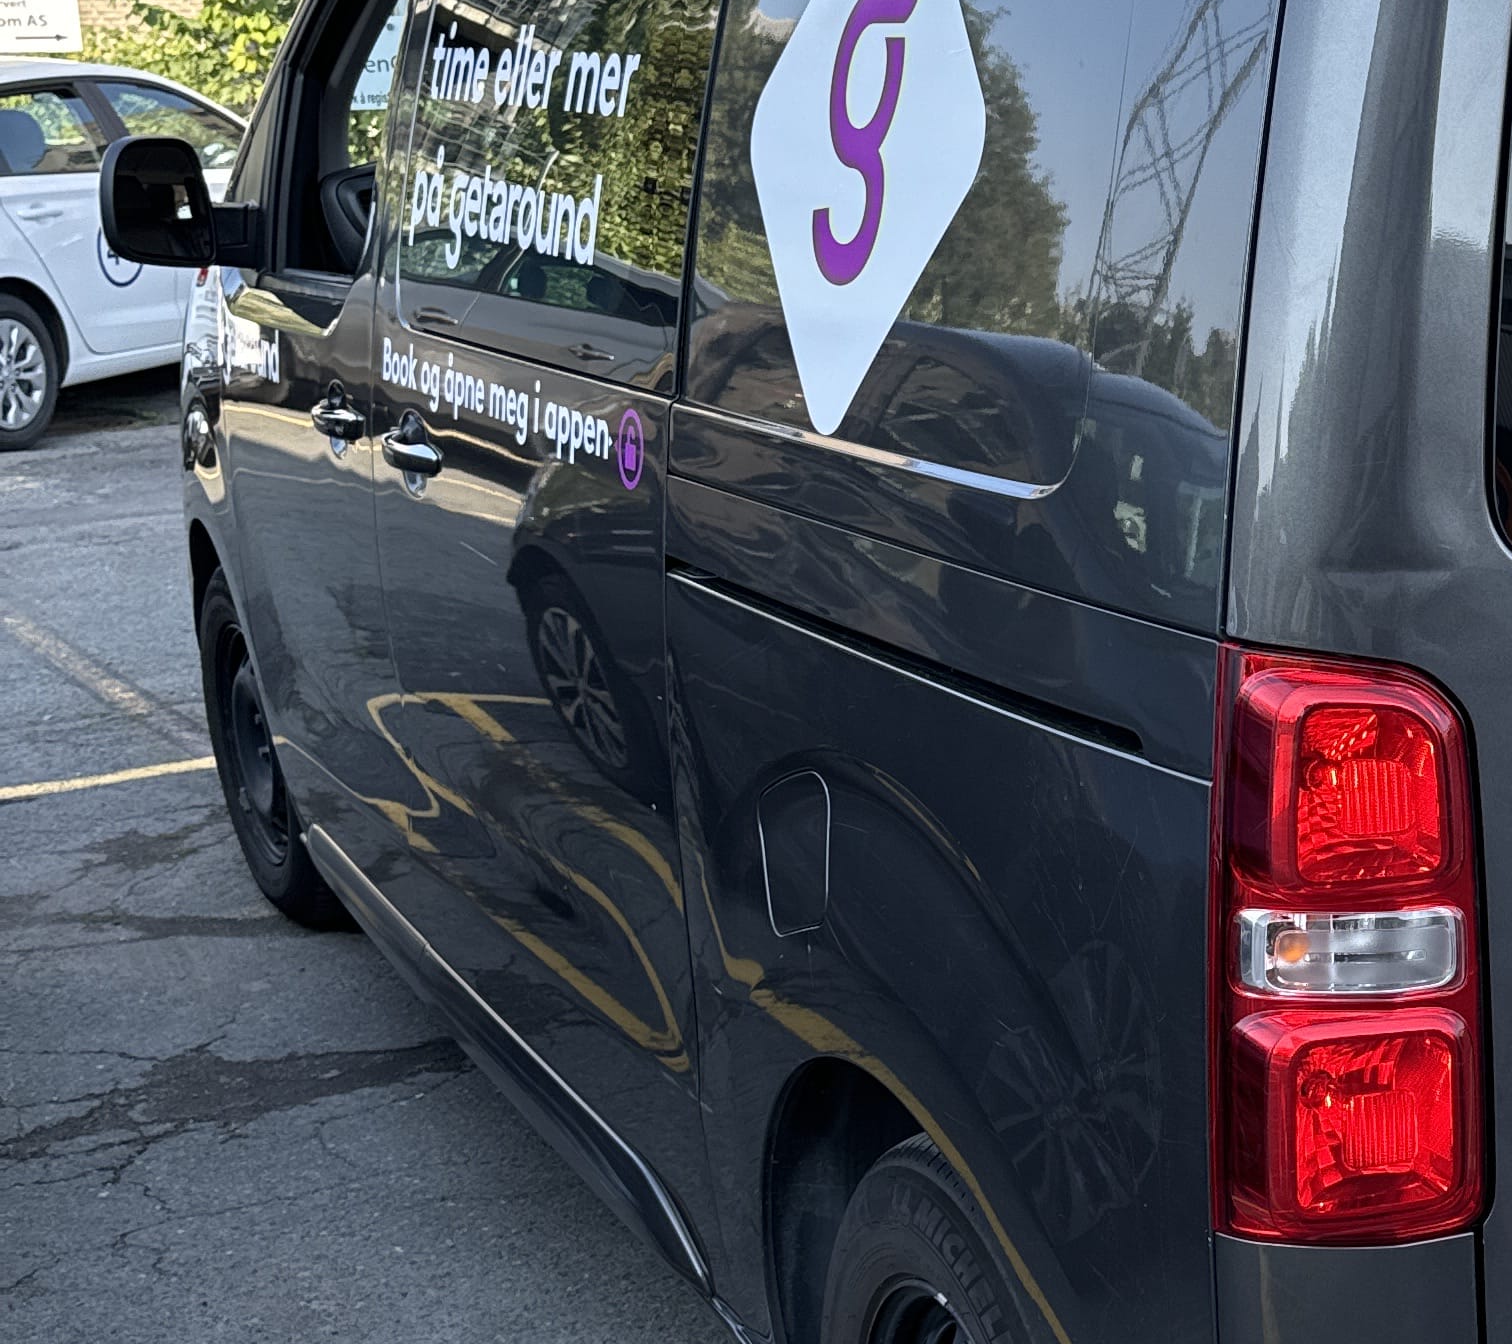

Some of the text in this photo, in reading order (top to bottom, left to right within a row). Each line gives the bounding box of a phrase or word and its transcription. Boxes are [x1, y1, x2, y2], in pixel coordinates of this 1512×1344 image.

[27, 14, 48, 28] AS
[430, 20, 641, 118] time eller mer
[407, 145, 602, 269] på getaround
[382, 336, 609, 465] Book og åpne meg i appen
